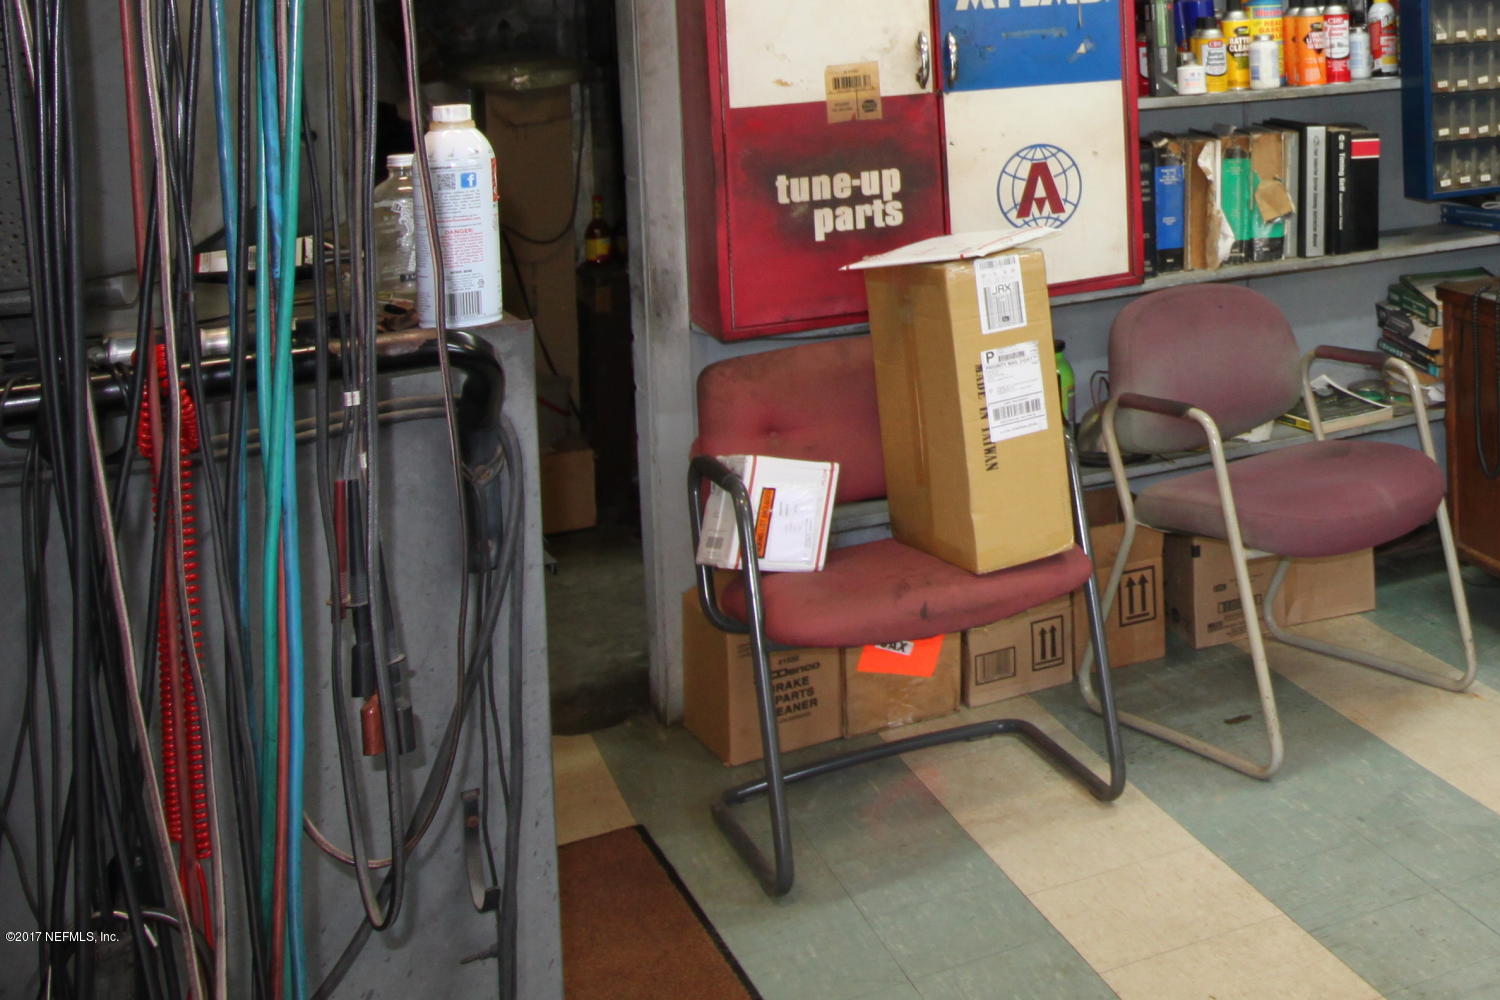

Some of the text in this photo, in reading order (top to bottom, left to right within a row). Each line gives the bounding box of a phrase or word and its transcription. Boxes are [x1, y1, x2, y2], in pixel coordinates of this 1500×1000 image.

[775, 168, 901, 205] tune-up
[813, 199, 904, 242] parts
[985, 351, 995, 364] P
[773, 675, 810, 693] RAKE
[775, 686, 815, 705] PARTS
[775, 697, 819, 717] EANER
